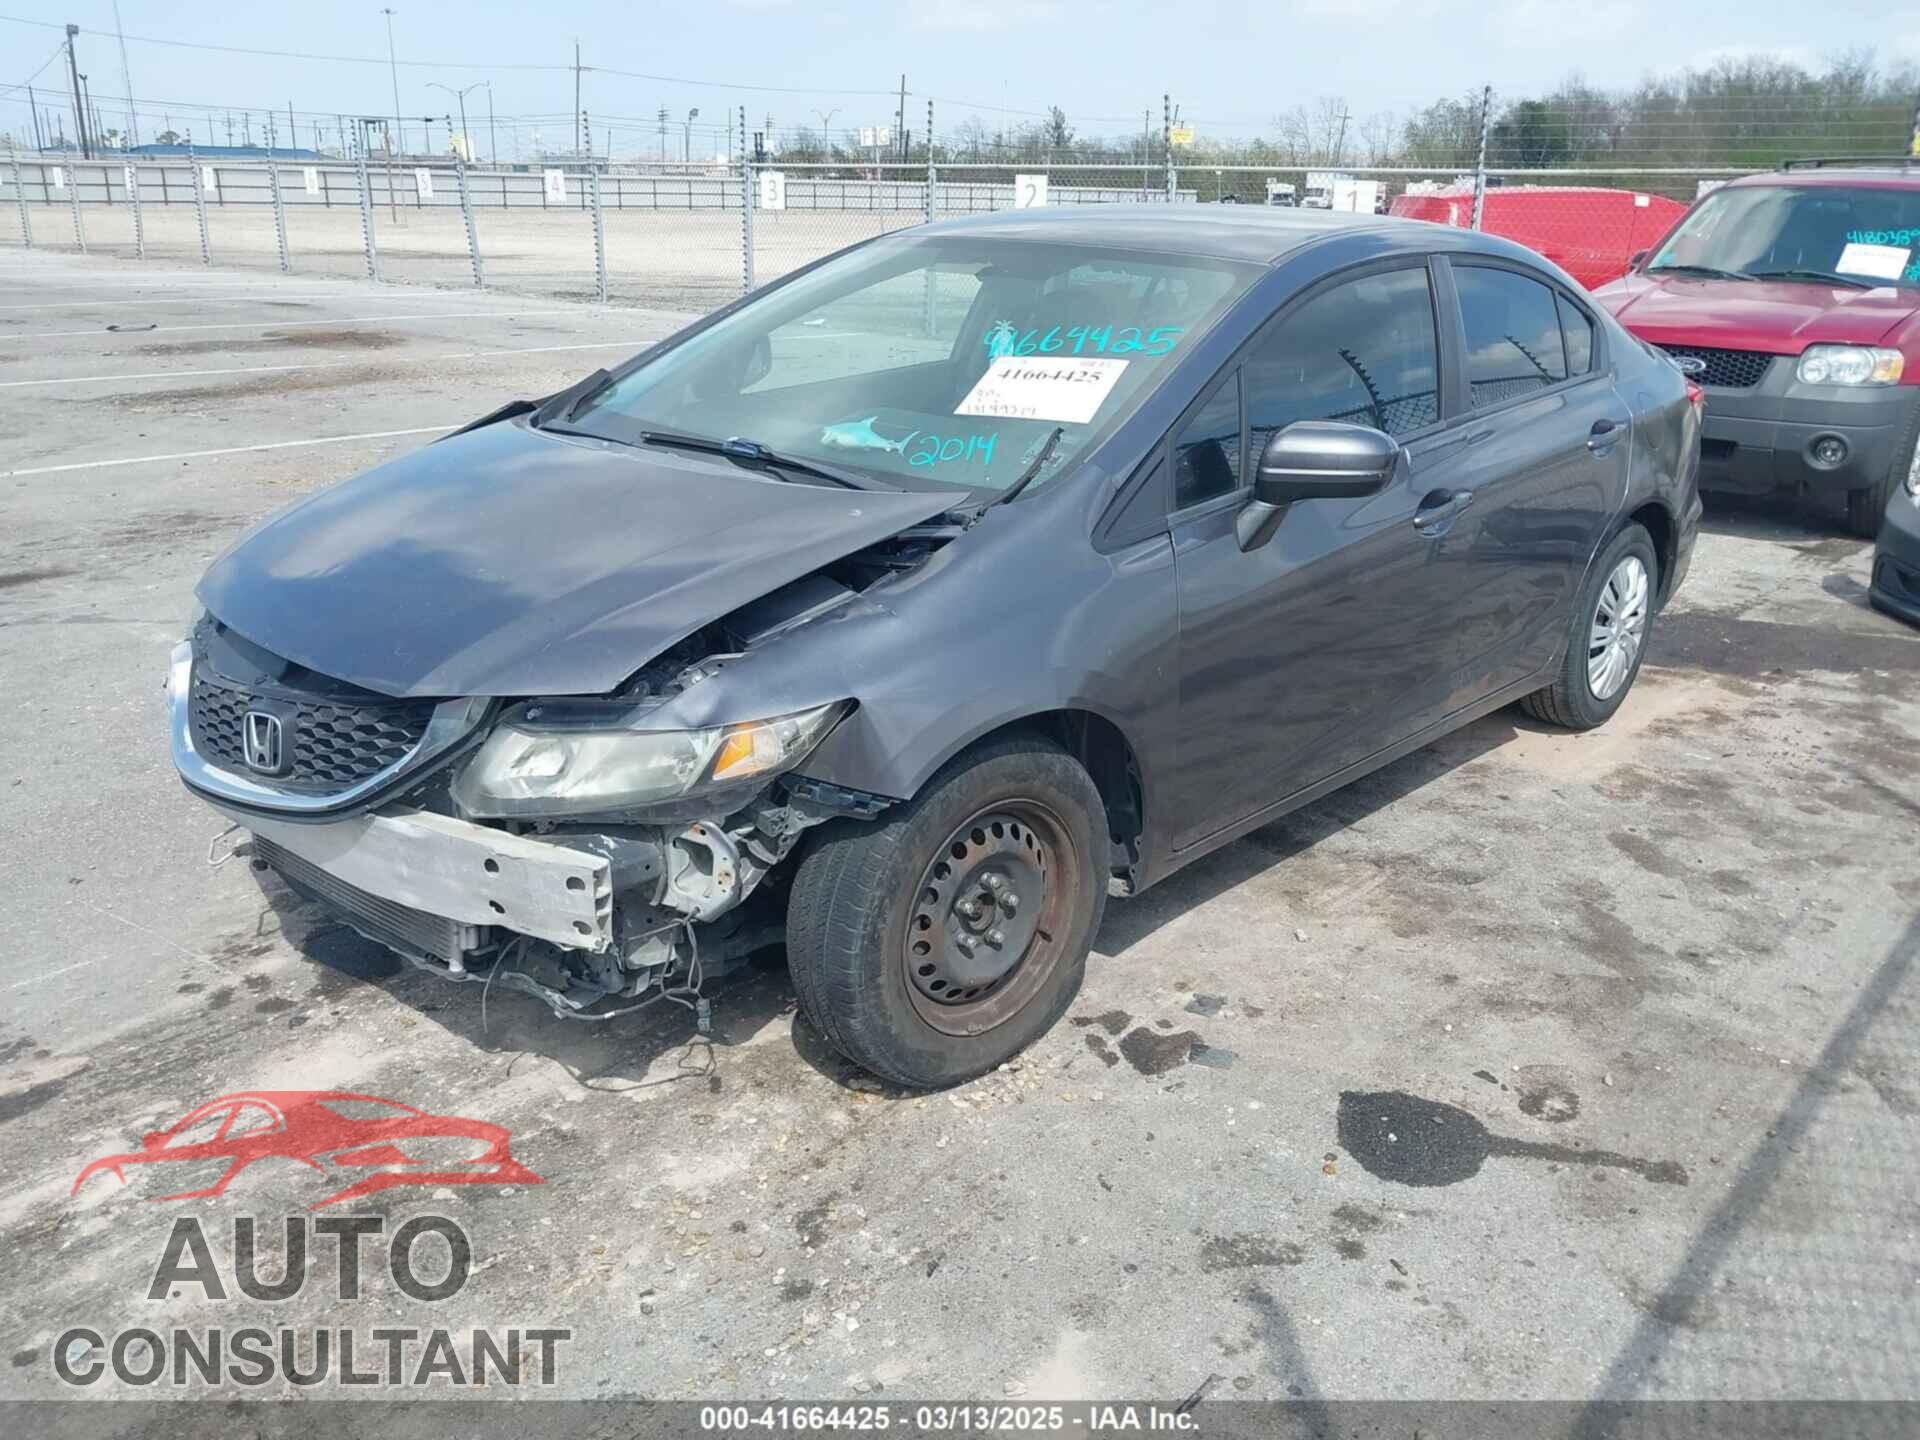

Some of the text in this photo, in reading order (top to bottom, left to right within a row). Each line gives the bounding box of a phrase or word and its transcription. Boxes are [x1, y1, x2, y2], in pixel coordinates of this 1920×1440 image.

[551, 175, 561, 192] 4
[768, 179, 777, 201] 3
[1025, 183, 1037, 208] 2
[1347, 190, 1357, 212] 1
[998, 367, 1103, 384] 41664425
[909, 432, 998, 466] 2014
